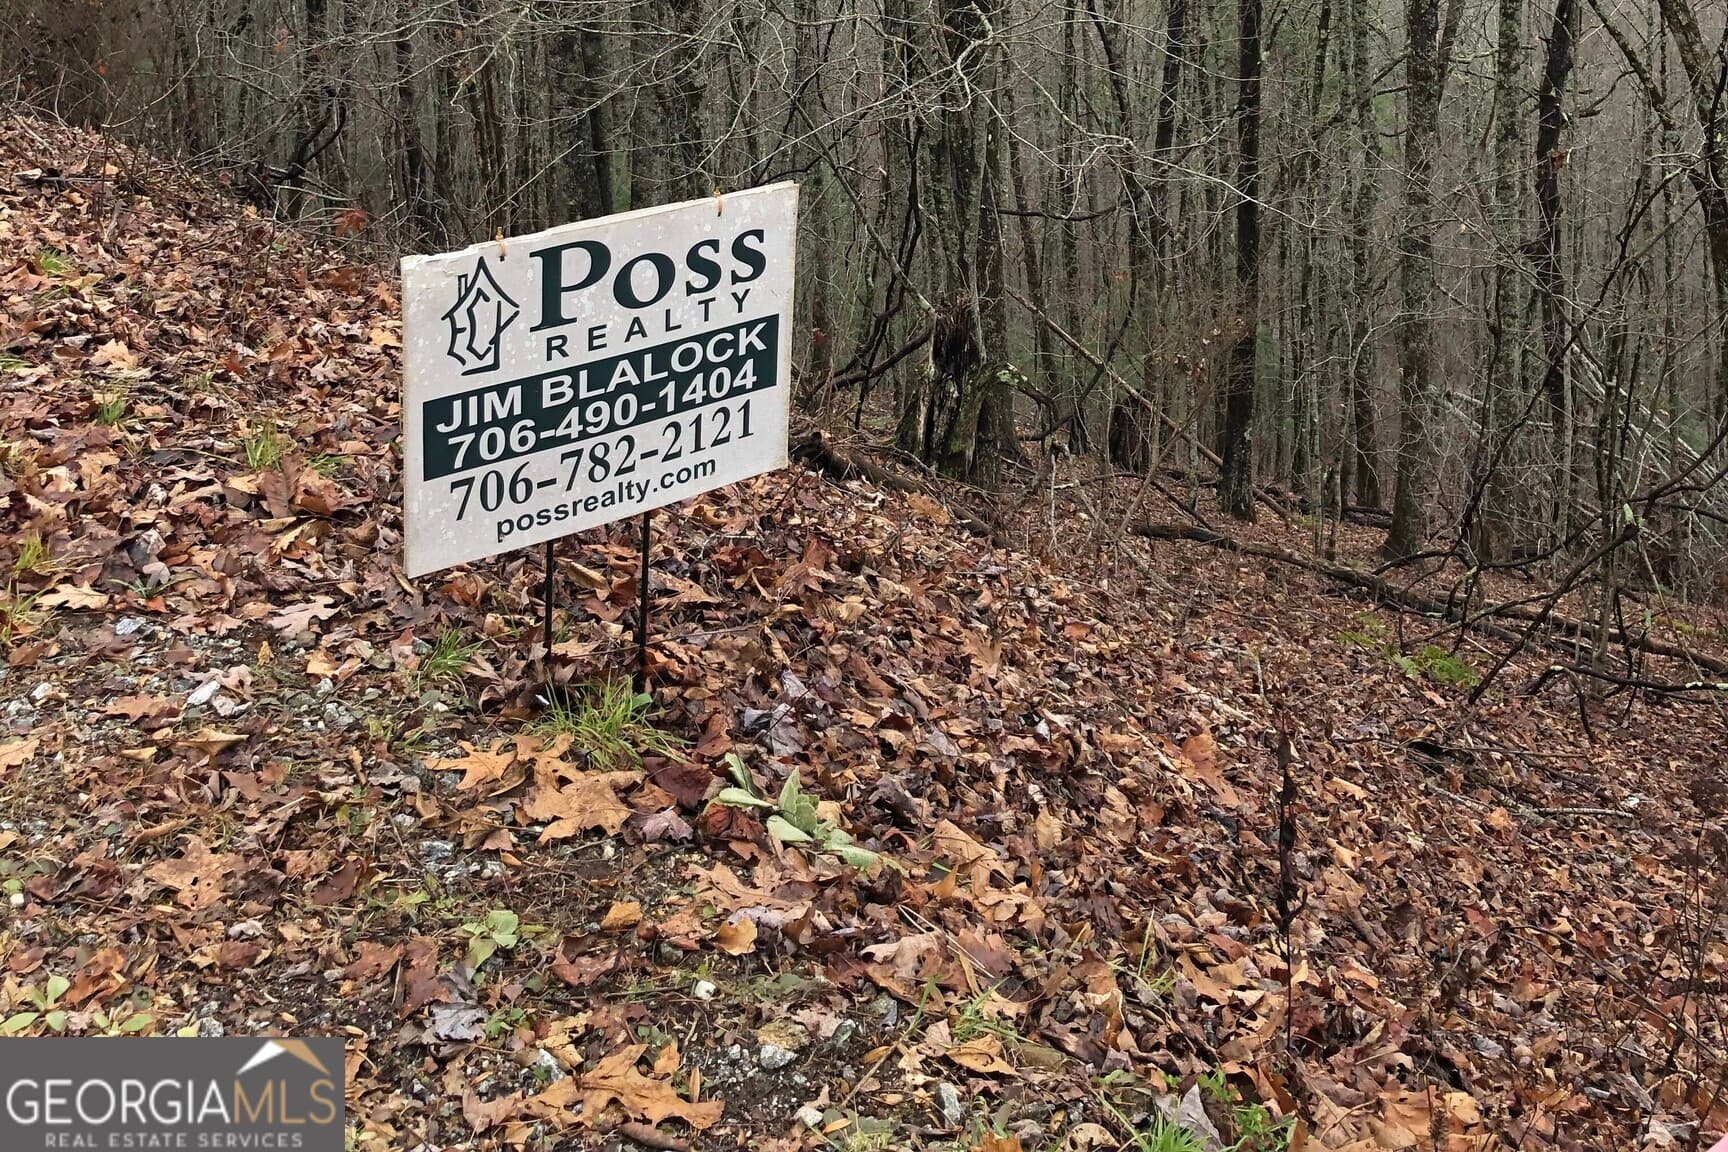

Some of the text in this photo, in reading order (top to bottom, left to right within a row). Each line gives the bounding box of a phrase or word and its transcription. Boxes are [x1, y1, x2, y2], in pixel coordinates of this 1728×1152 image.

[436, 322, 767, 433] JIM BLALOCK
[546, 289, 750, 361] REALTY
[447, 358, 756, 469] 706-490-1404
[450, 399, 754, 521] 706-782-2121
[497, 457, 716, 542] possrealty.com
